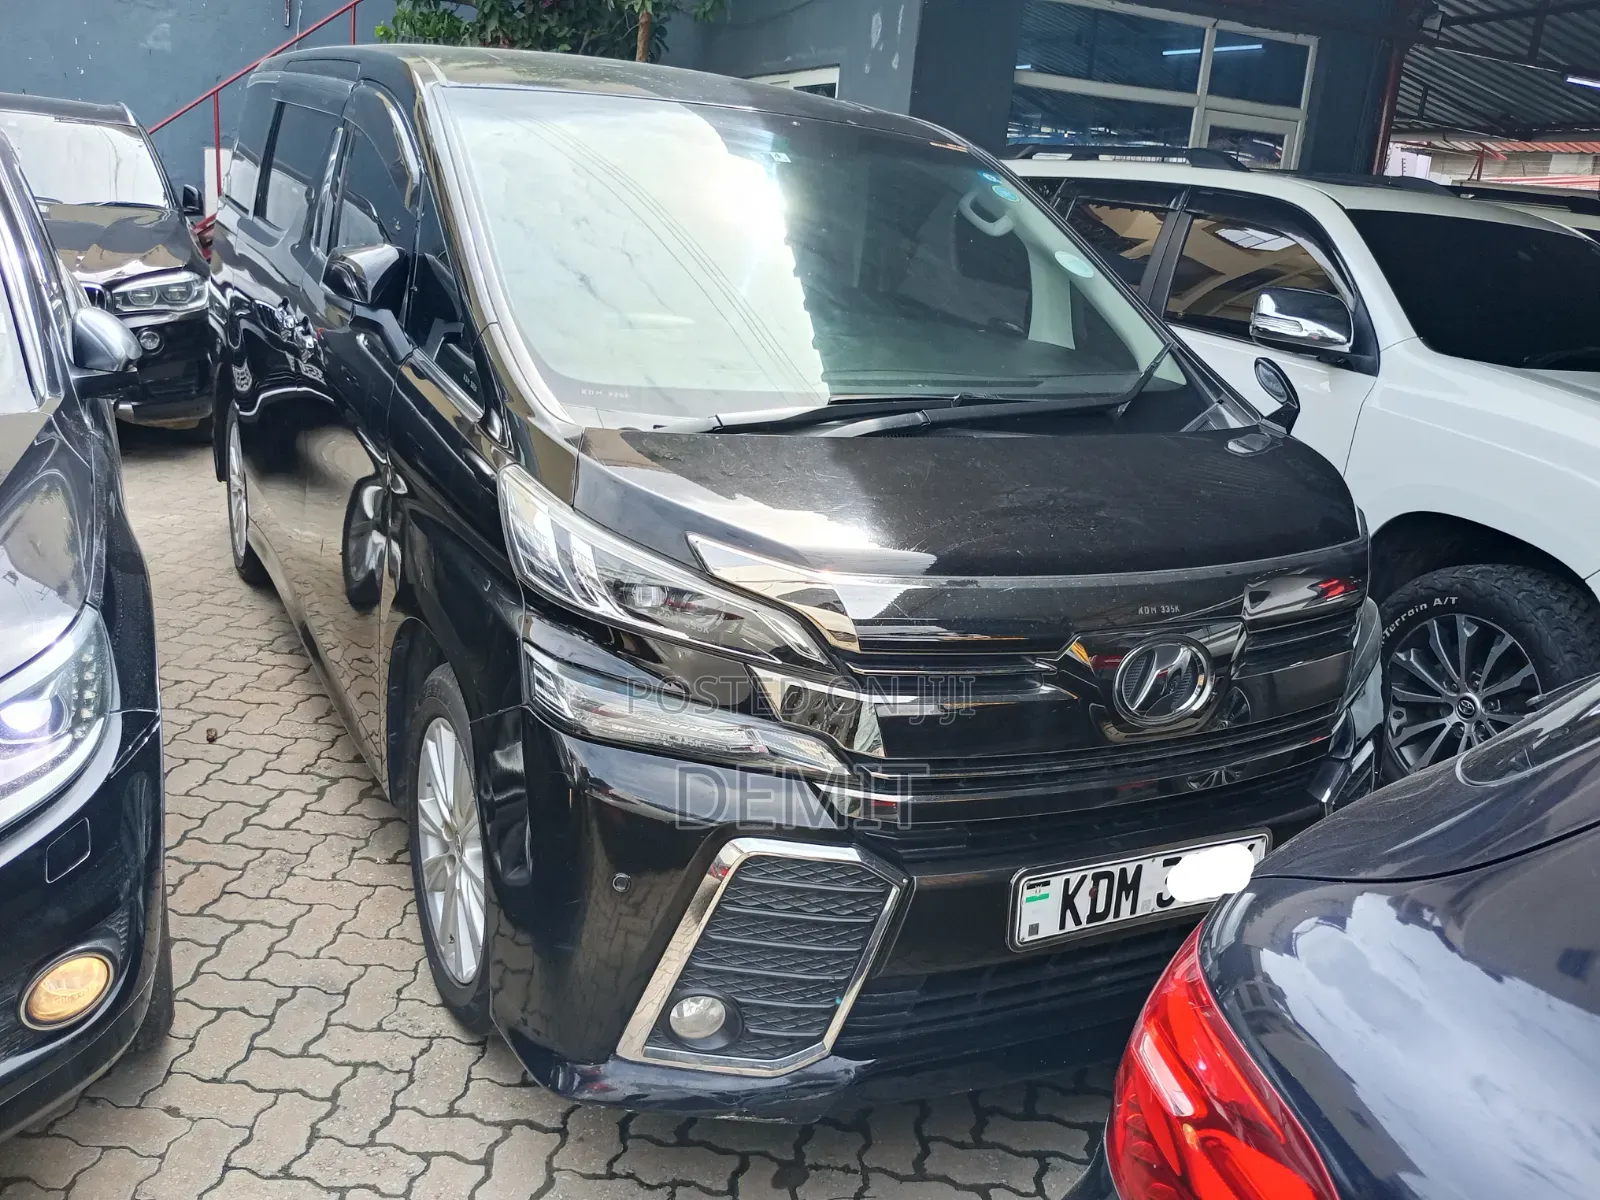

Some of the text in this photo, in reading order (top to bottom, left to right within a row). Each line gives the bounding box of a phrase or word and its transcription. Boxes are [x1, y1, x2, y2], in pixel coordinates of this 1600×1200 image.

[1432, 597, 1458, 607] A/T
[1138, 605, 1180, 614] KDM 335K
[1059, 864, 1143, 931] KDM
